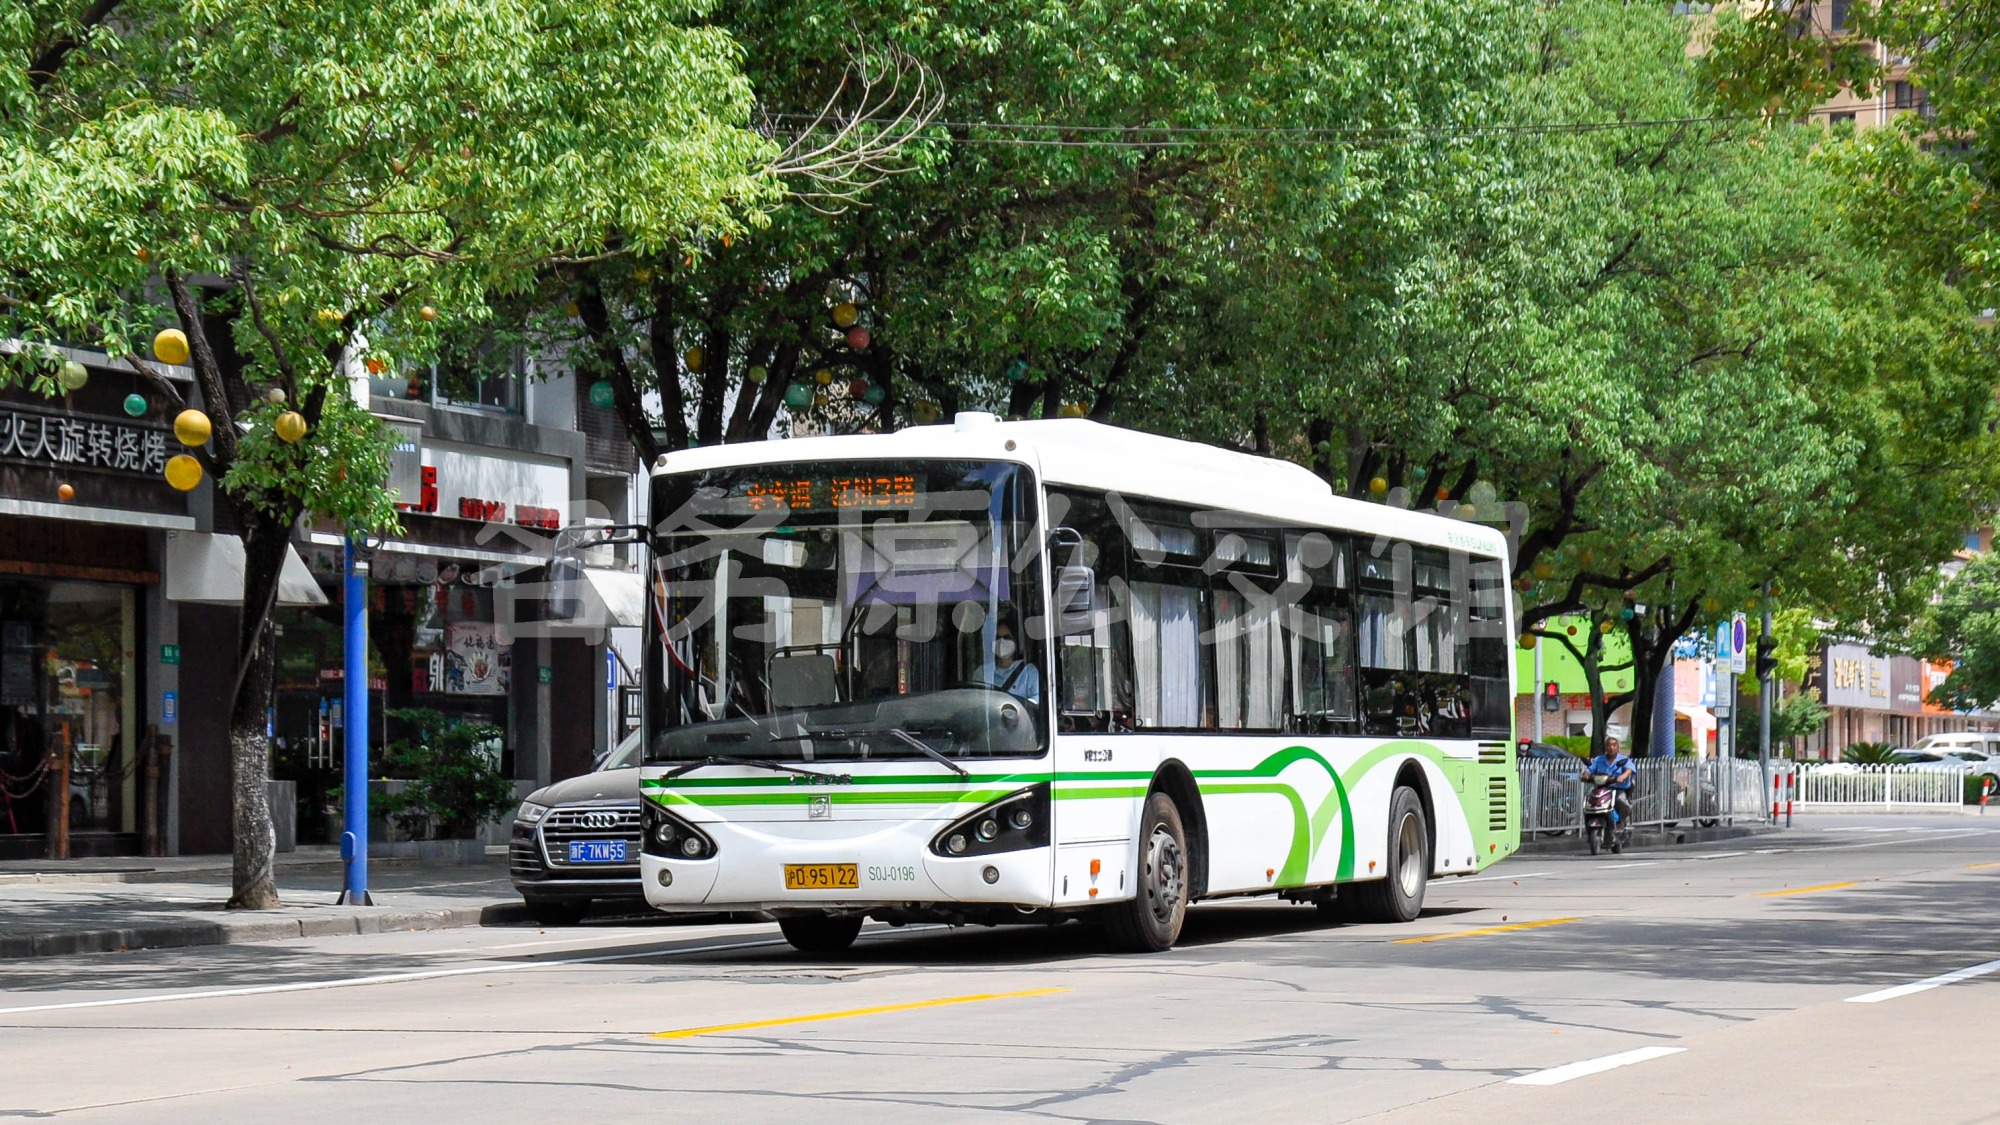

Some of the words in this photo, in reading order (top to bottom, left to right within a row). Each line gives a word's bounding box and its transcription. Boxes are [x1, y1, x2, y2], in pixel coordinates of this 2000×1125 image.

[2, 411, 166, 474] 火人旋转烧烤
[787, 868, 857, 886] 沪D·95122
